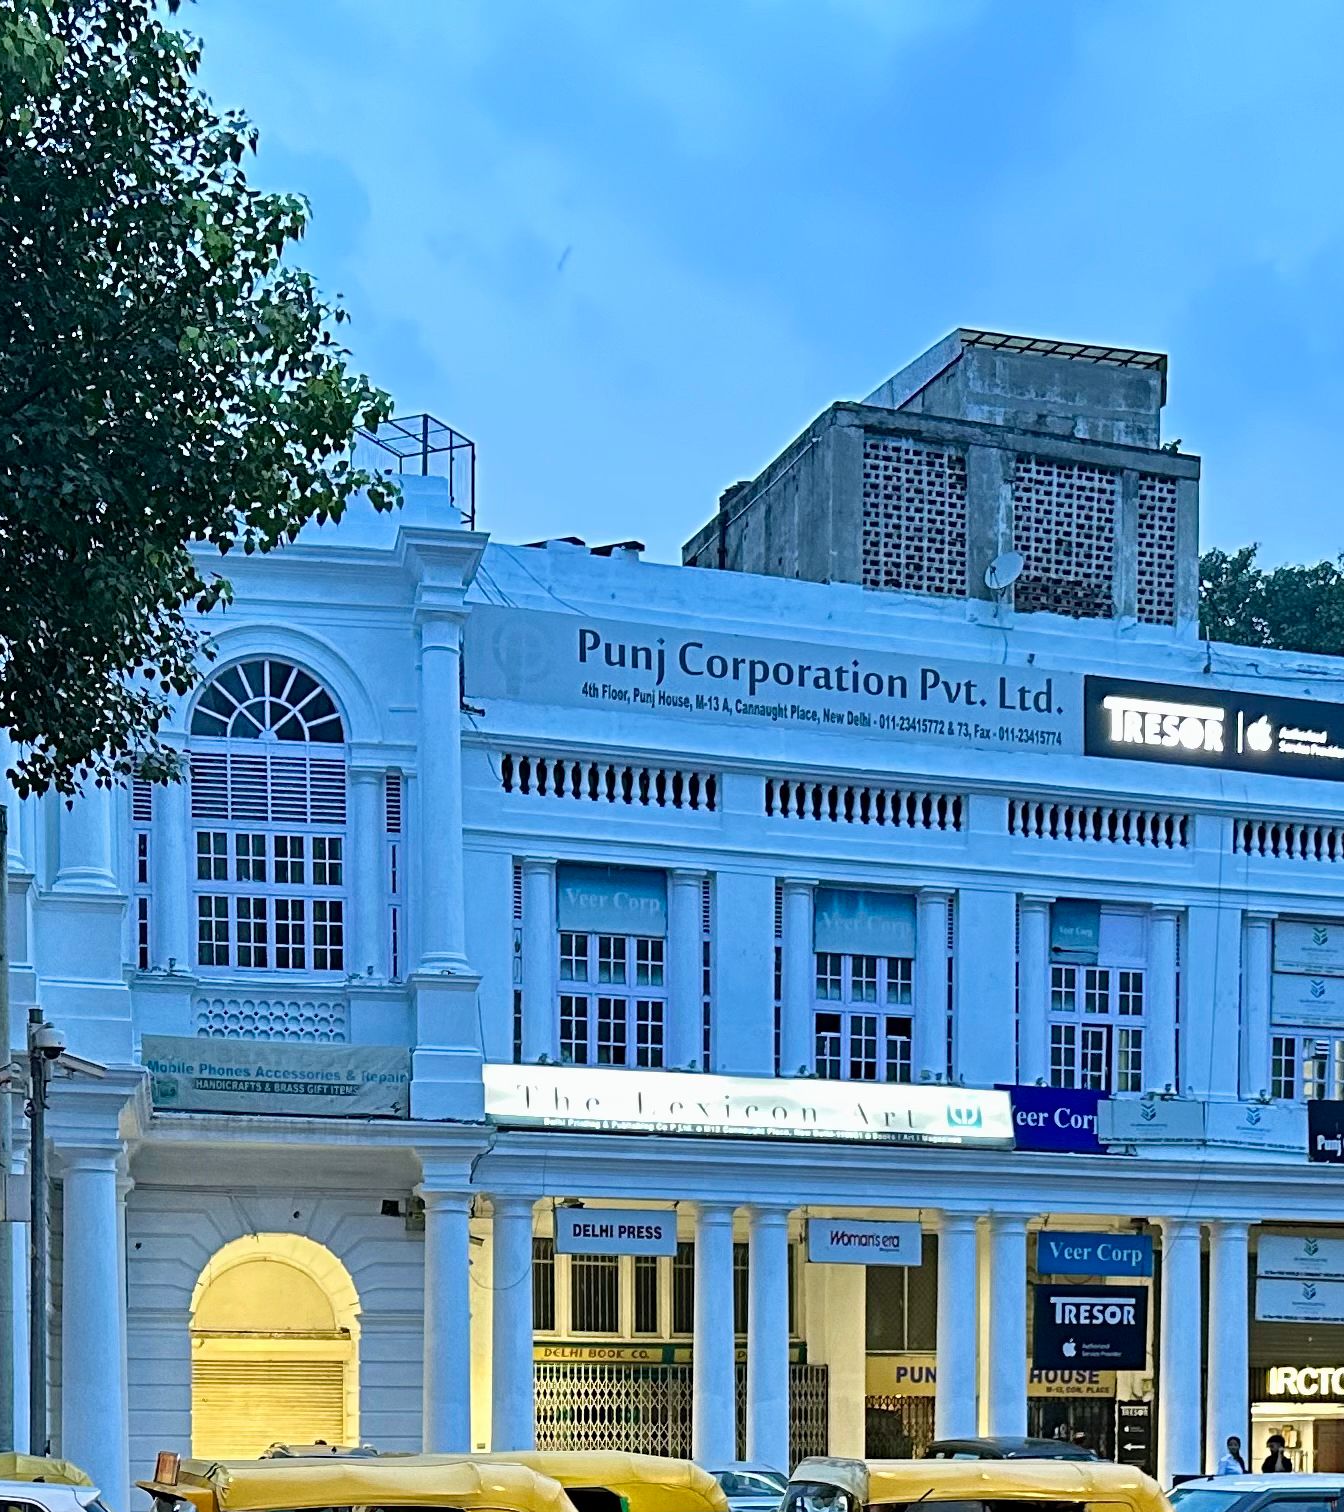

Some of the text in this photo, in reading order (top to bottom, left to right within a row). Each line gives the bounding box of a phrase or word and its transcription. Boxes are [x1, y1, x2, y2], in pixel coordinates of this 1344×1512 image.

[578, 628, 1064, 715] Punj Corporation Pvt. Ltd.
[581, 682, 599, 699] 4th
[601, 684, 631, 705] Floor,
[633, 687, 655, 708] Punj
[658, 690, 693, 712] House,
[695, 694, 720, 712] M-13
[790, 705, 821, 726] Place,
[822, 708, 844, 725] New
[846, 710, 872, 728] Delhi
[947, 721, 955, 736] &
[957, 722, 972, 740] 73,
[973, 724, 991, 740] Fax
[1103, 695, 1225, 752] TRESOR
[147, 1060, 194, 1075] Mobile
[199, 1063, 251, 1078] Phones
[255, 1065, 341, 1082] Accessories
[345, 1070, 356, 1082] &
[195, 1079, 359, 1096] HANDICRAFTS & BRASS GIFT ITEMS
[516, 1084, 601, 1113] The
[637, 1091, 817, 1123] Lexicon
[1011, 1106, 1049, 1127] eer
[1316, 1133, 1342, 1157] Punj
[572, 1223, 663, 1240] DELHI PRESS
[829, 1230, 900, 1248] Woman's era
[1049, 1241, 1143, 1267] Veer Corp
[1049, 1296, 1136, 1325] TRESOR
[543, 1347, 651, 1360] DELHI BOOK CO.
[1029, 1369, 1100, 1384] HOUSE
